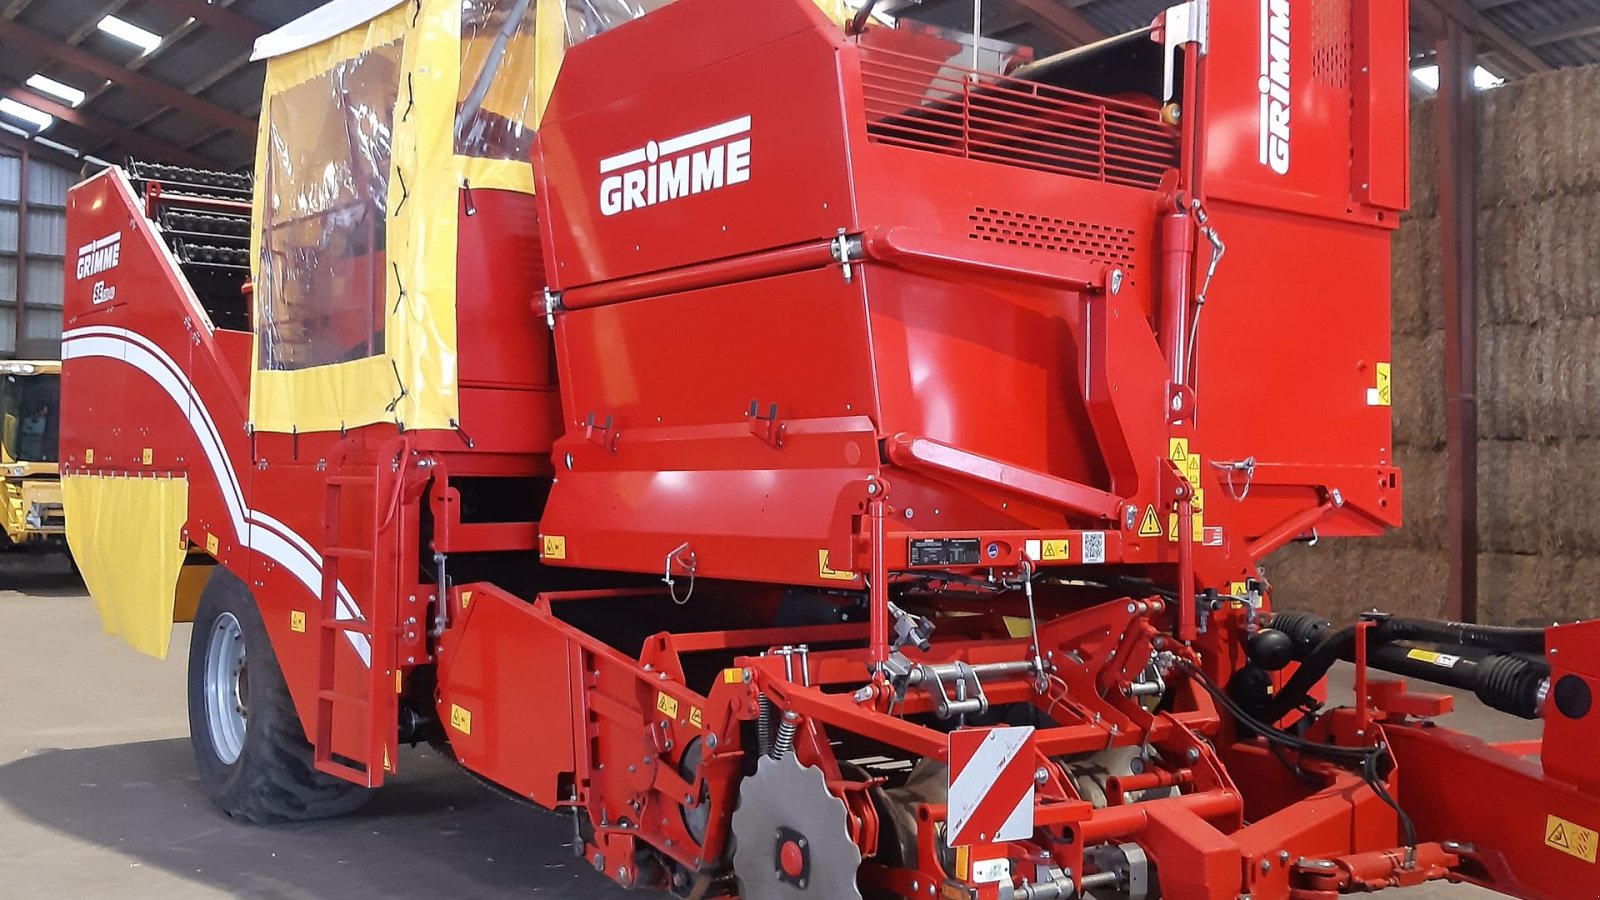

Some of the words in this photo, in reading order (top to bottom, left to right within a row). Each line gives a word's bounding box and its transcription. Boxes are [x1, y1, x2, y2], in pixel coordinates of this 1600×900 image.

[1258, 0, 1291, 175] GRIMM
[600, 137, 751, 216] GRIMME
[77, 240, 120, 280] GRIMME
